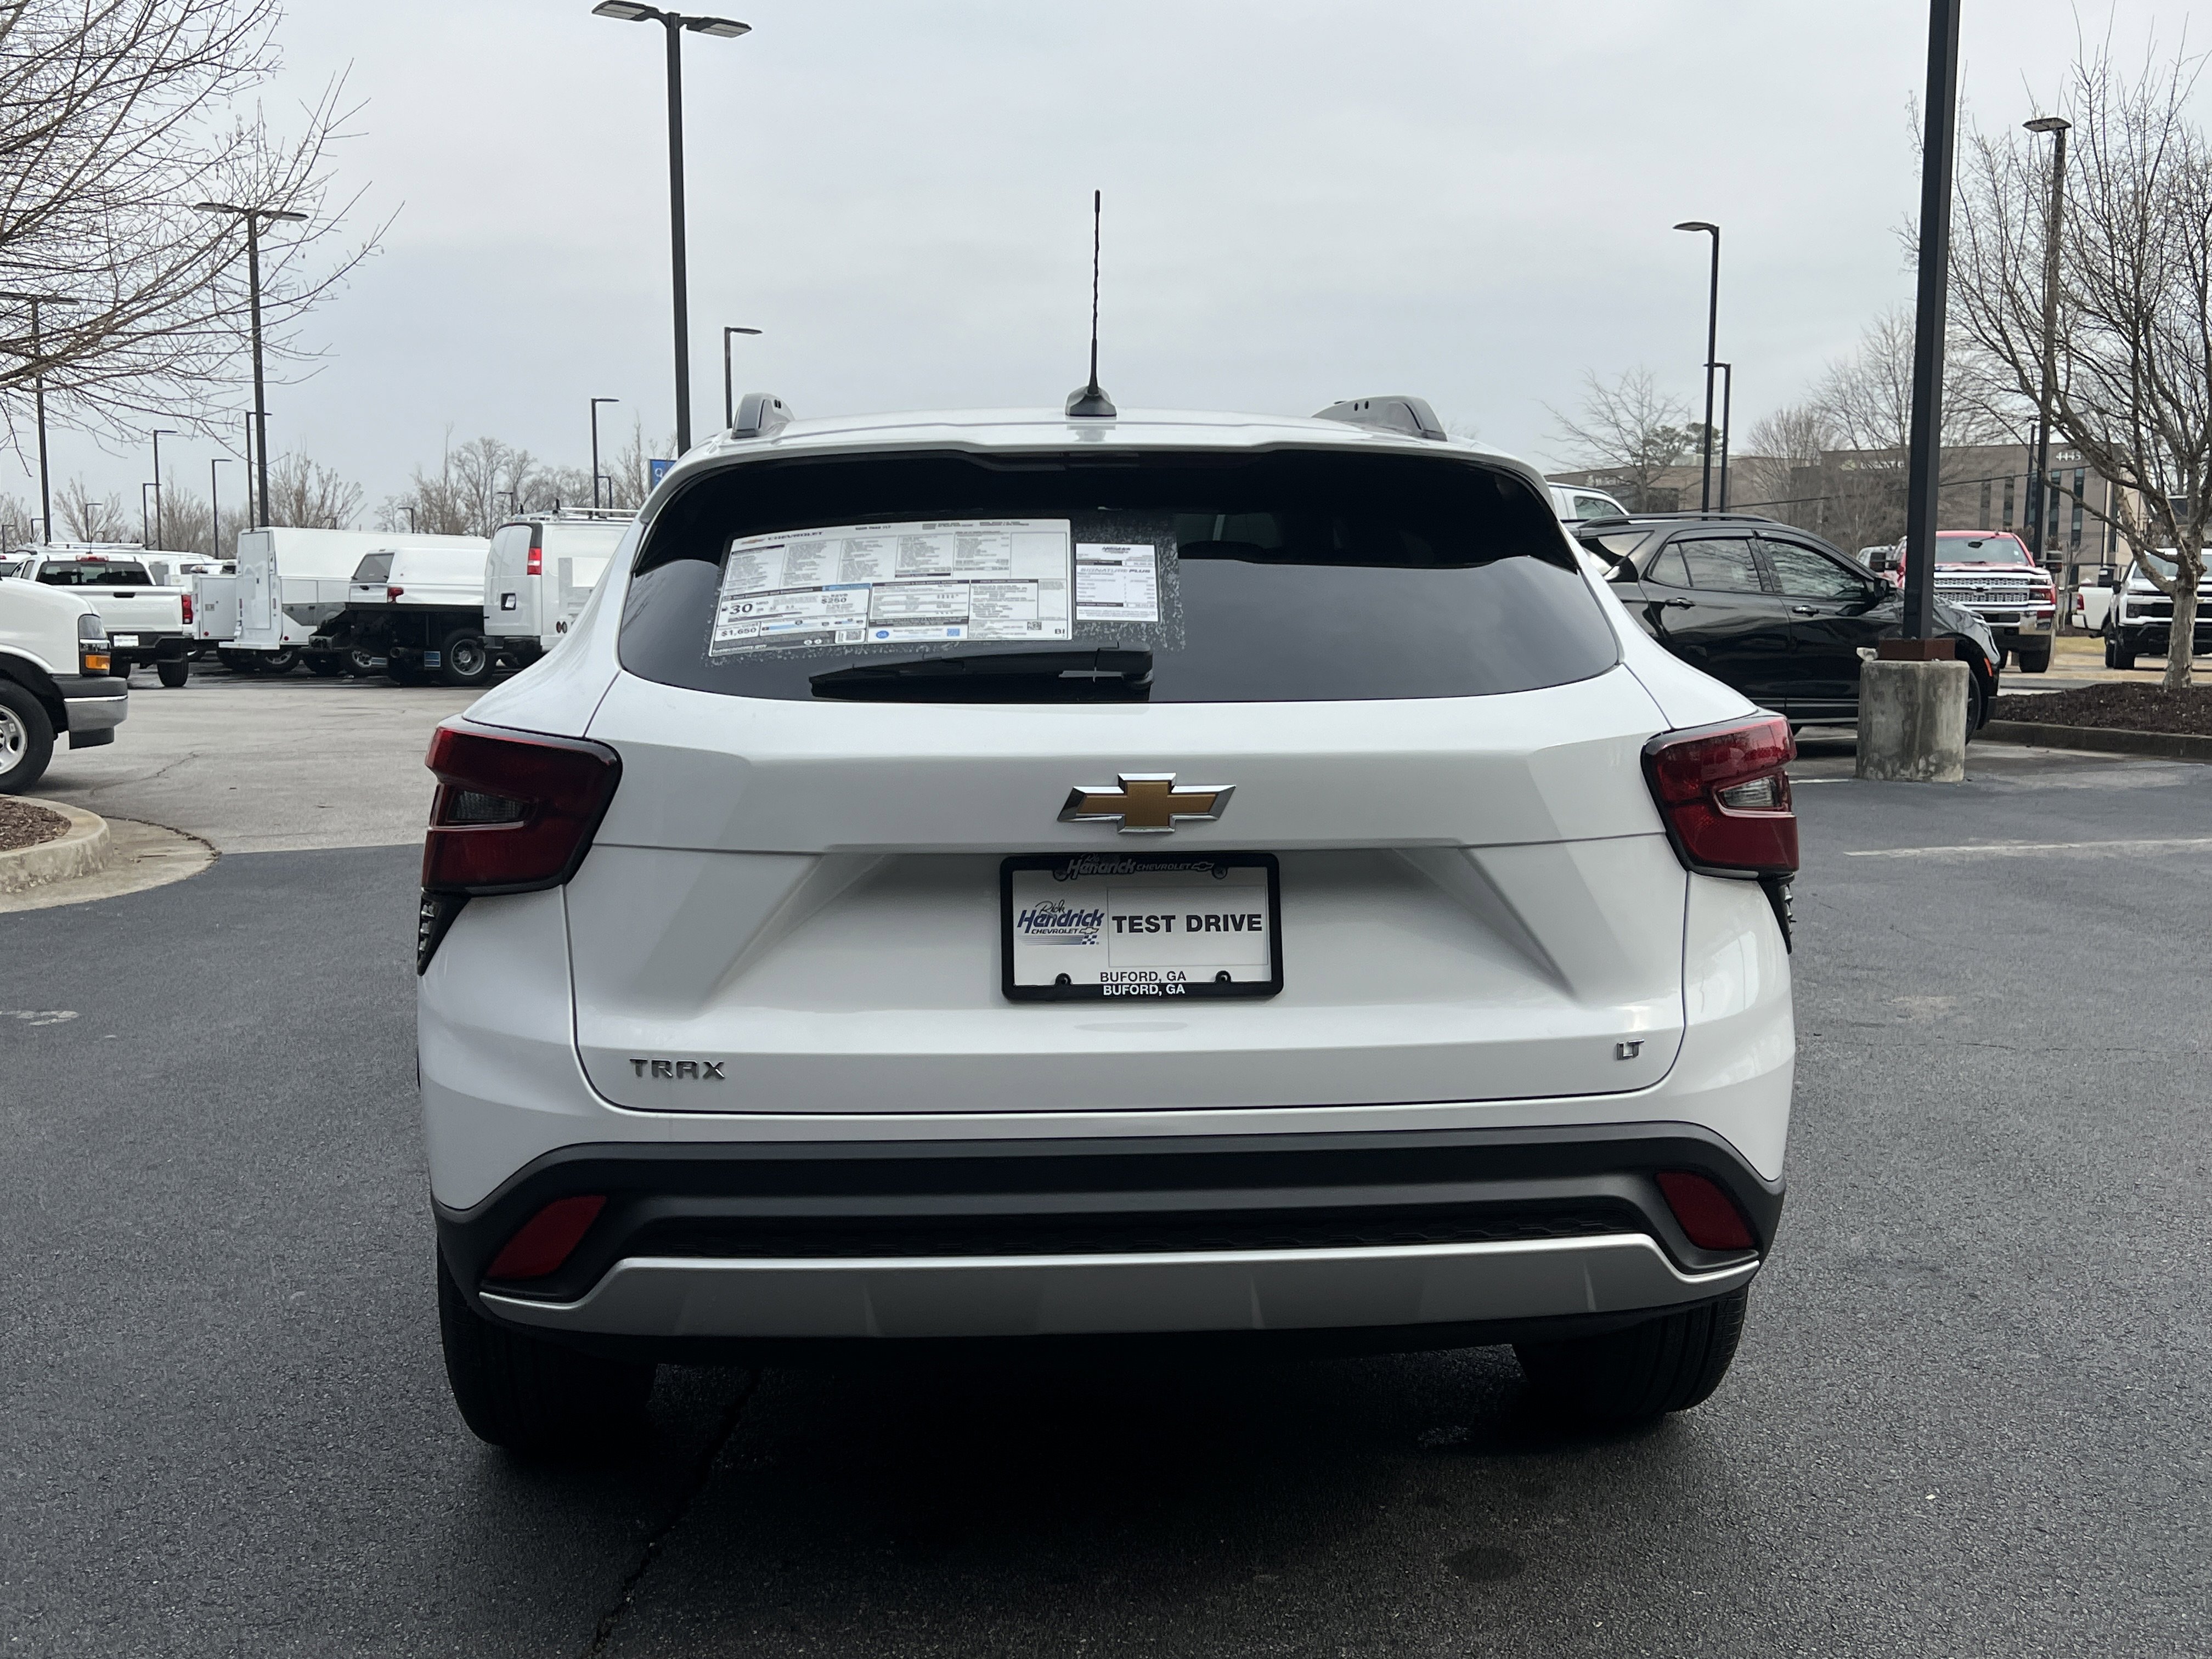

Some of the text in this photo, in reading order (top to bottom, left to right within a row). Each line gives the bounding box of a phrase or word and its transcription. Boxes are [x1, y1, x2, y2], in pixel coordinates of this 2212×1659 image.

[2056, 452, 2081, 461] 4445
[729, 603, 753, 614] 30
[721, 627, 757, 637] $1,650
[1136, 863, 1191, 871] CHEVROLET
[1035, 899, 1066, 916] Rick
[1017, 909, 1105, 934] Hendrick
[1111, 913, 1263, 934] TEST DRIVE
[1100, 970, 1187, 983] BUFORD, GA
[1103, 984, 1186, 997] BUFORD, GA
[1616, 1039, 1645, 1060] LT
[629, 1058, 726, 1079] TRAX
